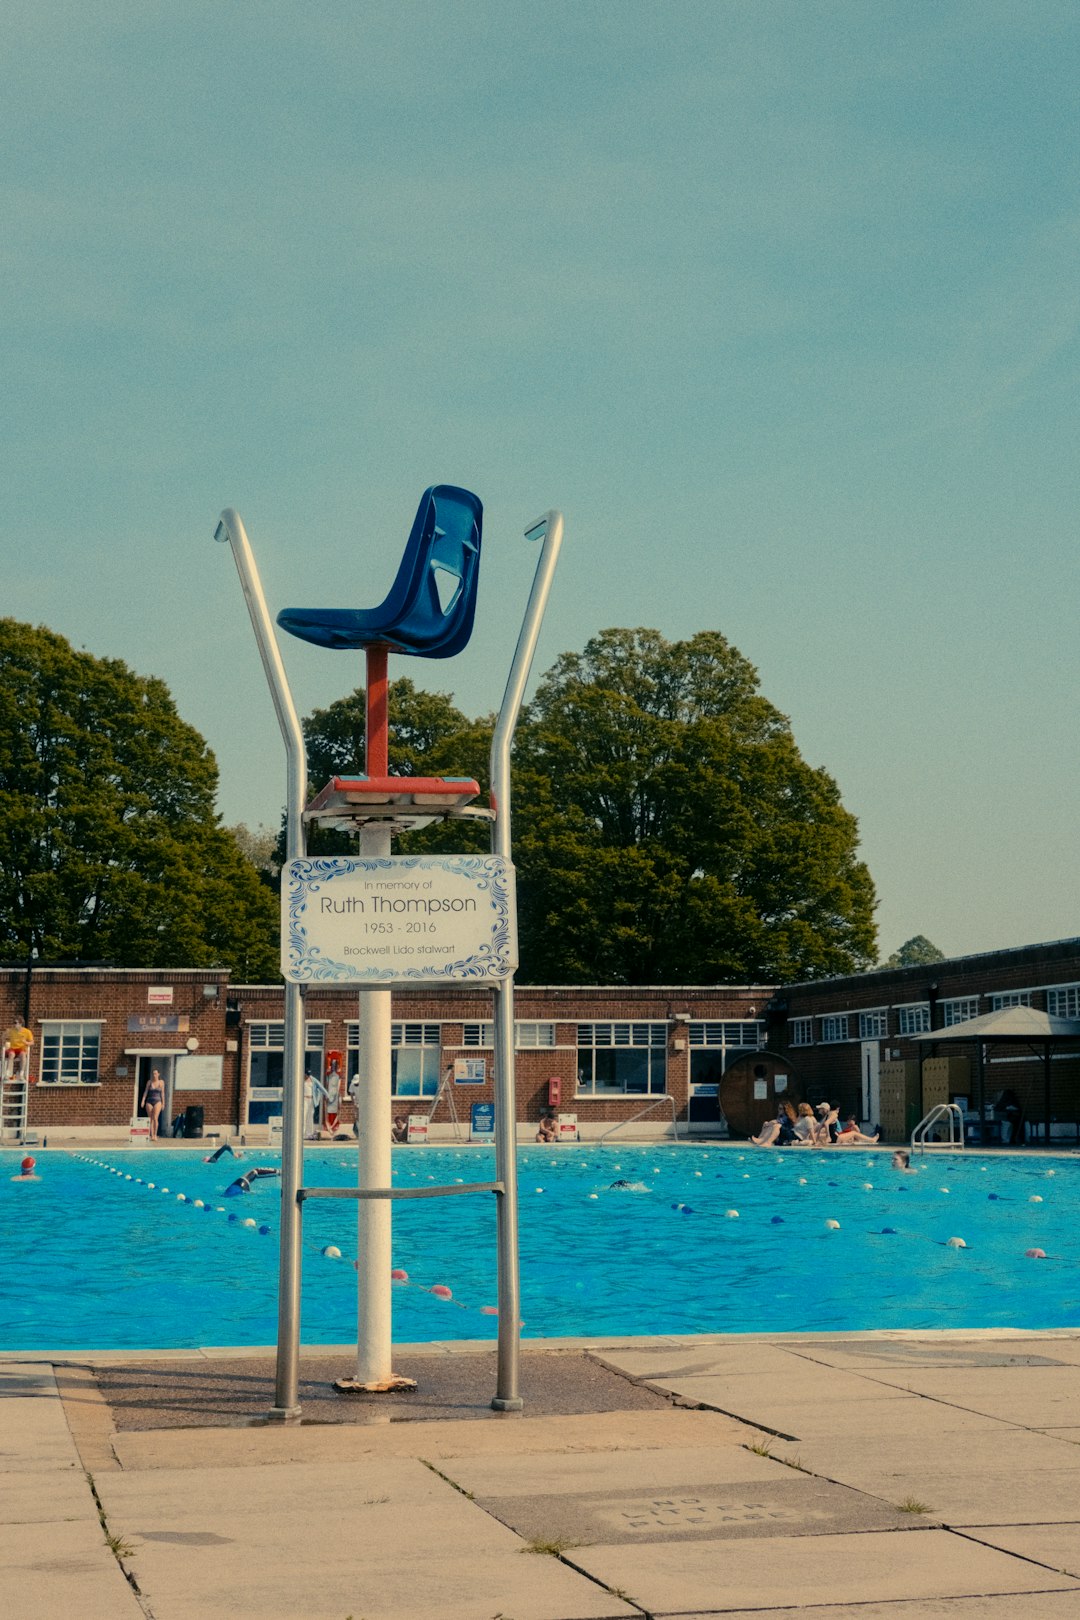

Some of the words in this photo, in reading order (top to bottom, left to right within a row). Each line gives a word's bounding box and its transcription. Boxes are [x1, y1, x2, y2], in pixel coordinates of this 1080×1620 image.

[364, 880, 373, 890] In
[376, 881, 420, 891] memory
[422, 880, 433, 889] of
[320, 896, 365, 913] Ruth
[371, 895, 477, 916] Thompson
[364, 922, 394, 934] 1953
[405, 921, 437, 933] 2016
[343, 946, 391, 956] Brockwell
[393, 945, 415, 955] Lido
[417, 944, 455, 955] stalwart
[652, 1498, 700, 1506] NO
[621, 1503, 767, 1519] LITTER
[629, 1512, 797, 1528] PLEASE
